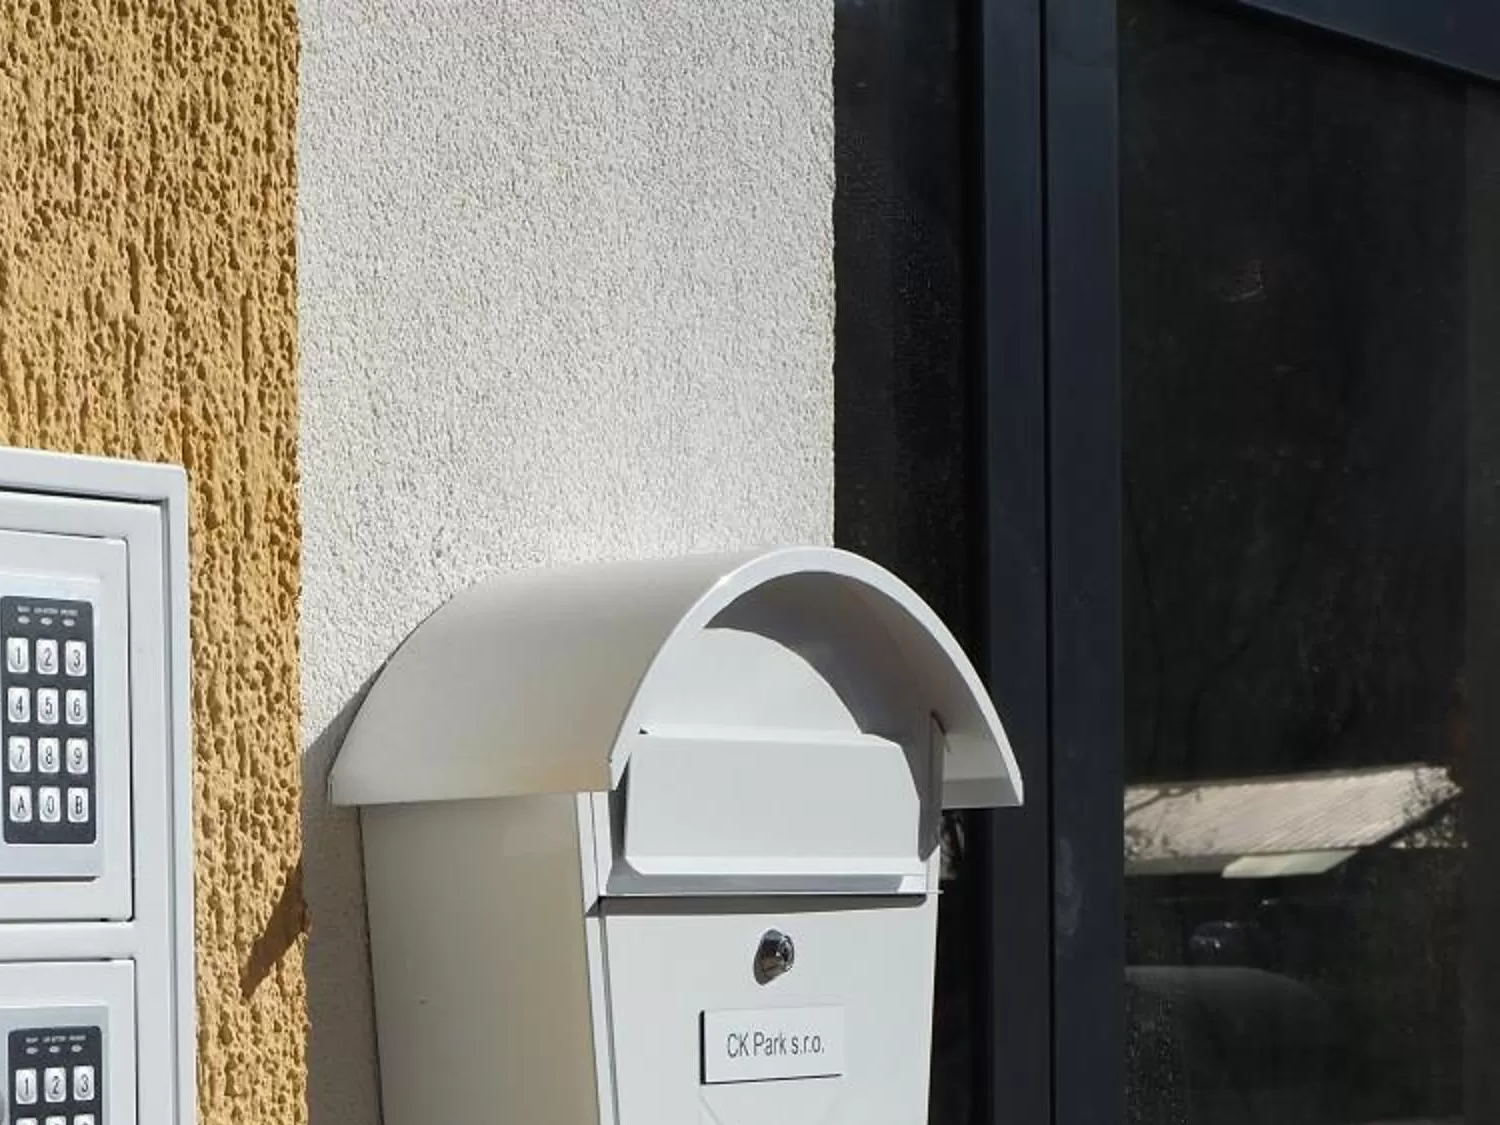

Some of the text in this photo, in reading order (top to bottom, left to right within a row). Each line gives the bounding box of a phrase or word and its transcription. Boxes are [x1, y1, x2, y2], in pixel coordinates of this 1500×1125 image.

[43, 648, 53, 667] 2
[72, 650, 82, 668] 3
[14, 696, 82, 717] 4 5 6
[16, 745, 83, 765] 7 8 9
[16, 796, 26, 814] A
[74, 796, 84, 814] B
[727, 1031, 825, 1058] CK Park s.r.o.
[51, 1076, 61, 1095] 2
[80, 1074, 90, 1092] 3
